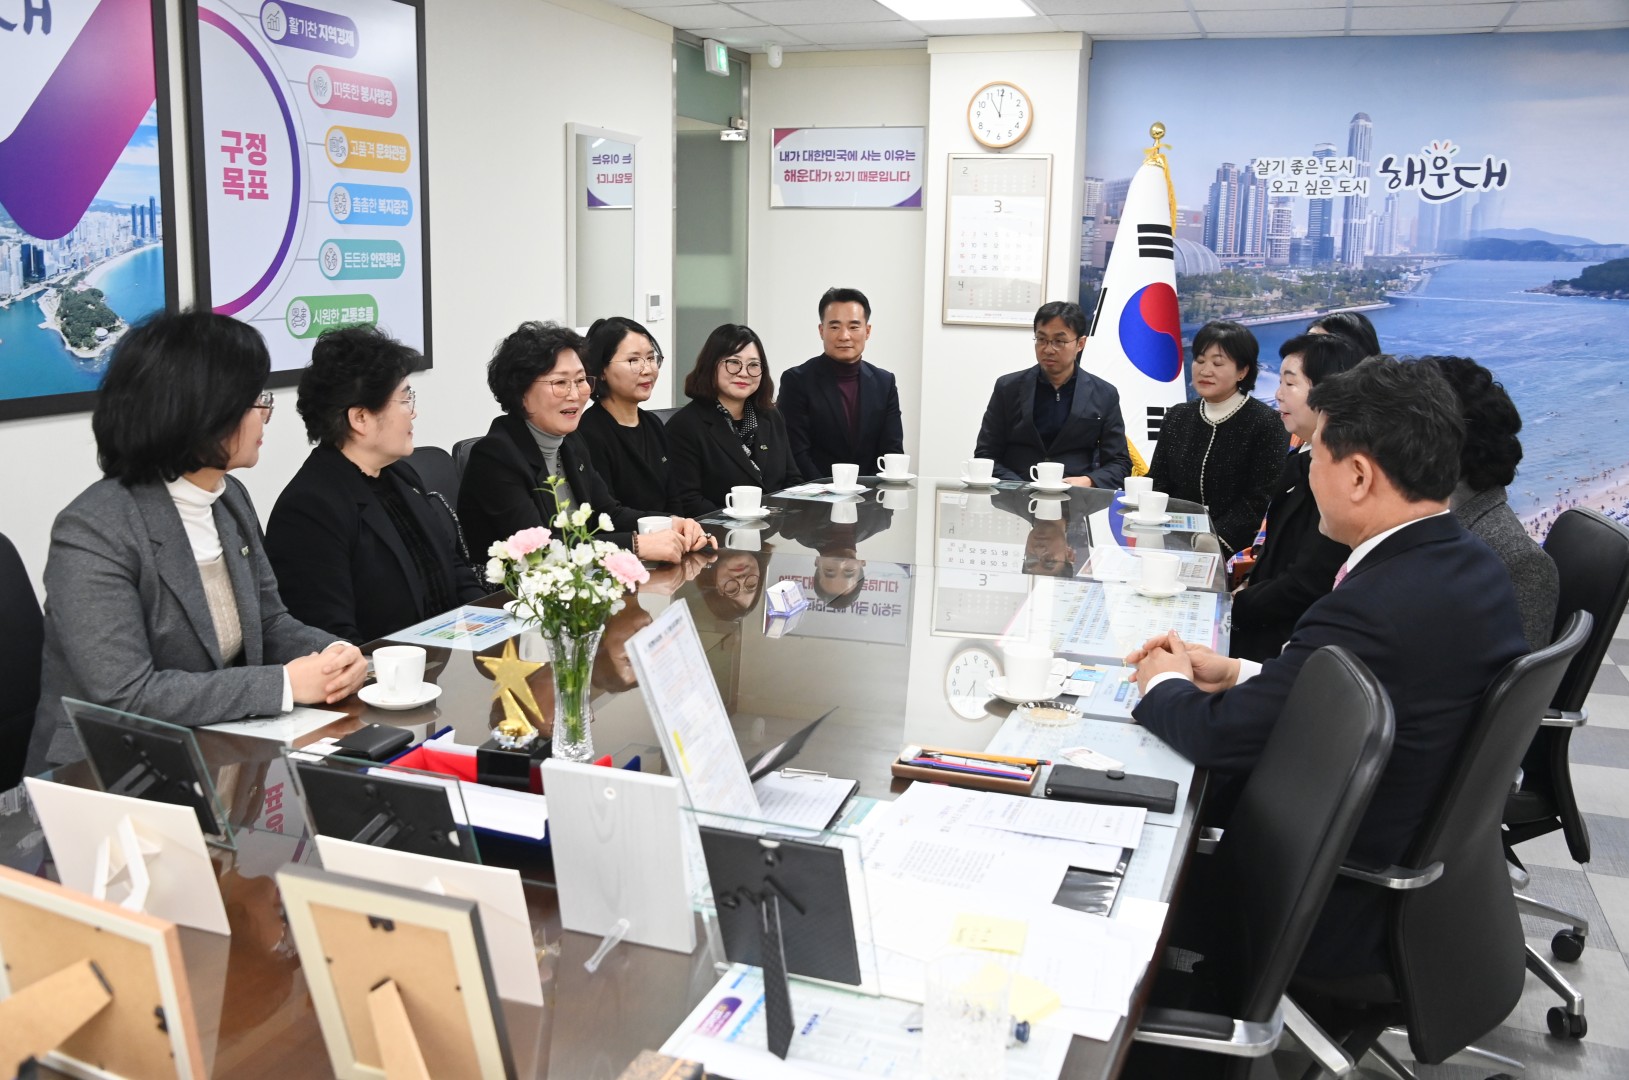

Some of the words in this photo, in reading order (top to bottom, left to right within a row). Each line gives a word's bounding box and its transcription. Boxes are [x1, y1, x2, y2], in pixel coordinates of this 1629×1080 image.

[288, 16, 318, 39] 활기찬
[318, 23, 354, 48] 지역경제
[333, 81, 360, 101] 따뜻한
[360, 86, 393, 106] 봉사행정
[220, 130, 268, 166] 구정
[350, 140, 375, 160] 고품격
[779, 150, 801, 162] 내가
[802, 149, 858, 162] 대한민국에
[860, 150, 881, 162] 사는
[884, 149, 916, 162] 이유는
[784, 168, 832, 183] 해운대가
[834, 171, 855, 183] 있기
[857, 170, 911, 183] 때문입니다
[962, 166, 968, 175] 2
[1255, 158, 1286, 176] 살기
[1290, 158, 1319, 176] 좋은
[1323, 158, 1354, 175] 도시
[222, 167, 269, 201] 목표
[1379, 155, 1508, 201] 해운대
[1270, 179, 1299, 194] 오고
[1304, 179, 1333, 196] 싶은
[1337, 179, 1368, 195] 도시
[352, 196, 377, 214] 촘촘한
[993, 199, 1002, 213] 3
[344, 251, 370, 268] 든든한
[370, 251, 401, 268] 안전확보
[958, 280, 964, 289] 4
[312, 308, 340, 325] 시원한
[341, 306, 374, 323] 교통흐름
